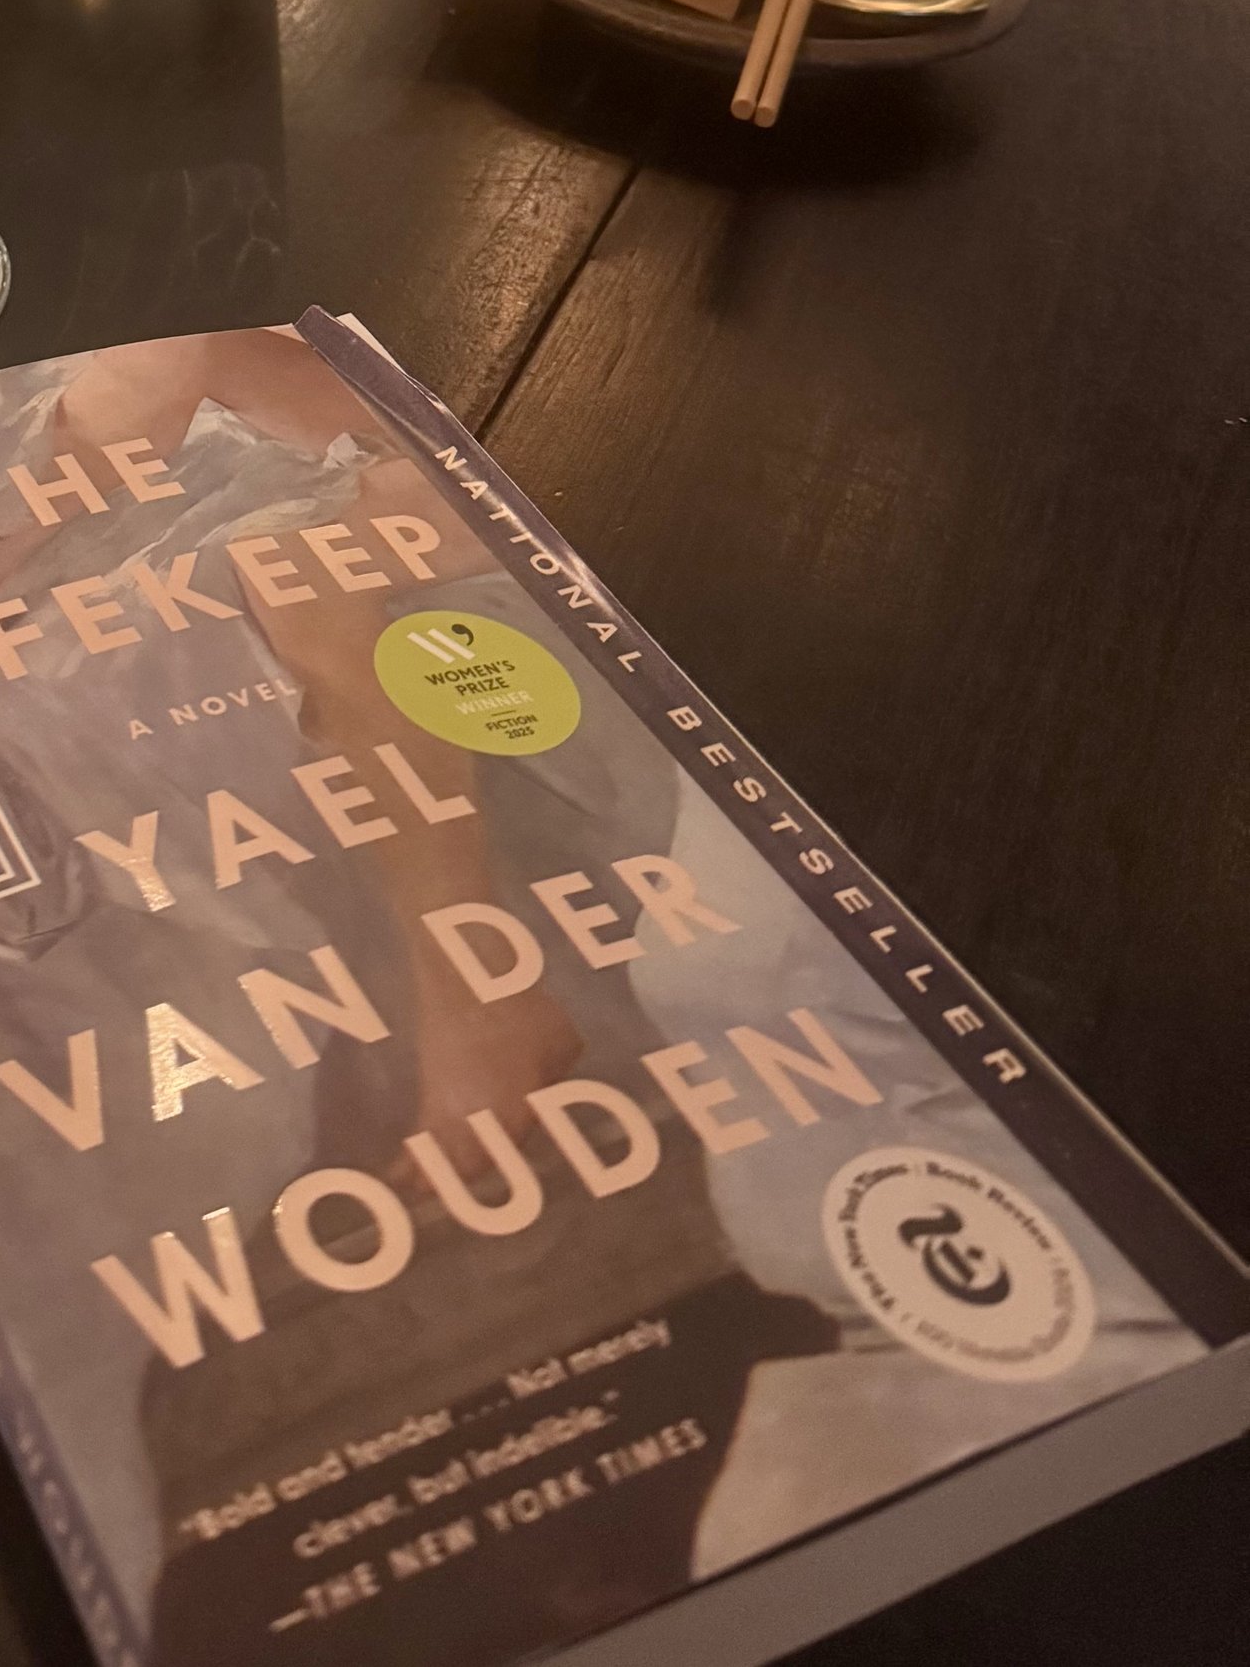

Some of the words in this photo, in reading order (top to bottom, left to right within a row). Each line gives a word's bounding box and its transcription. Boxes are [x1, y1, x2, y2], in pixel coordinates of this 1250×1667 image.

[424, 659, 516, 686] WOMEN'S
[455, 676, 510, 697] PRIZE
[129, 719, 153, 740] A
[168, 679, 297, 726] NOVEL
[455, 690, 534, 715] WINNER
[485, 714, 538, 732] FICTION
[434, 446, 642, 673] NATIONAL
[666, 705, 1026, 1084] BESTSELLER
[74, 742, 477, 913] YAEL
[420, 854, 742, 1004] DER
[91, 1007, 883, 1370] WOUDEN
[275, 1449, 348, 1501] and
[387, 1516, 477, 1581] NEW
[483, 1465, 595, 1532] YORK
[596, 1417, 709, 1484] TIMES
[407, 1459, 470, 1504] but
